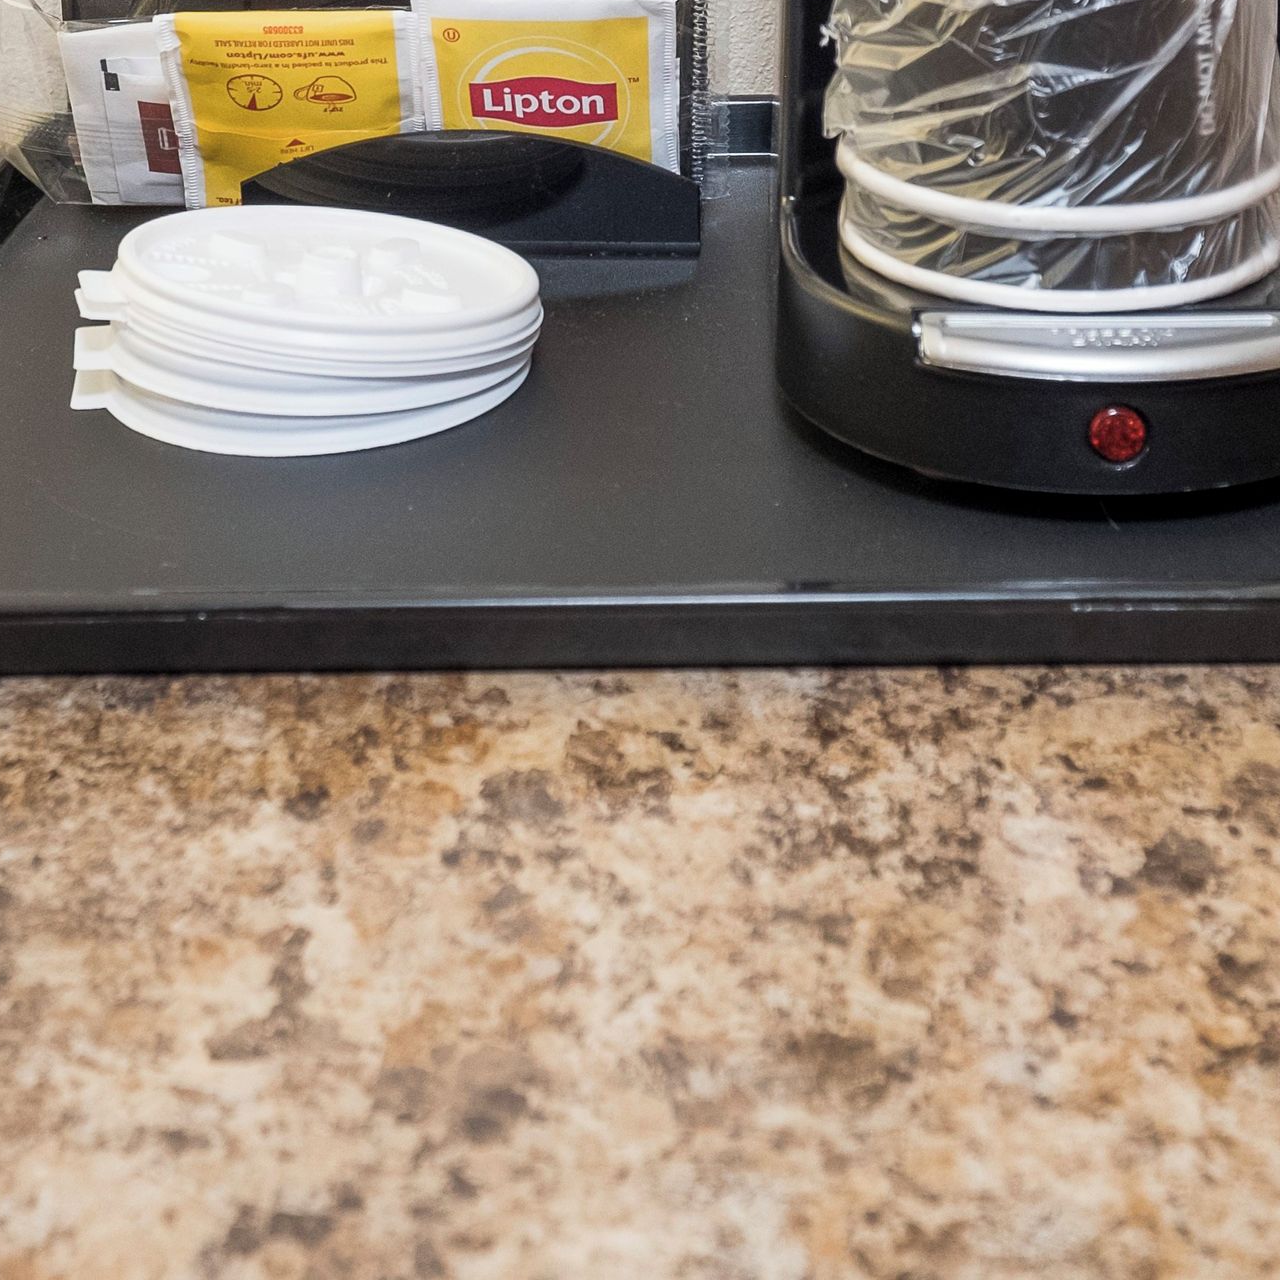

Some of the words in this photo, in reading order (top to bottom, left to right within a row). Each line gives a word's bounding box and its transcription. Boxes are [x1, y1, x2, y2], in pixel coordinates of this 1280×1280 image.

[214, 40, 233, 48] SALE
[257, 40, 272, 48] FOR
[321, 39, 338, 47] UNIT
[226, 51, 345, 60] www.ufs.com/Lipton
[334, 57, 369, 67] product
[482, 87, 605, 118] Lipton
